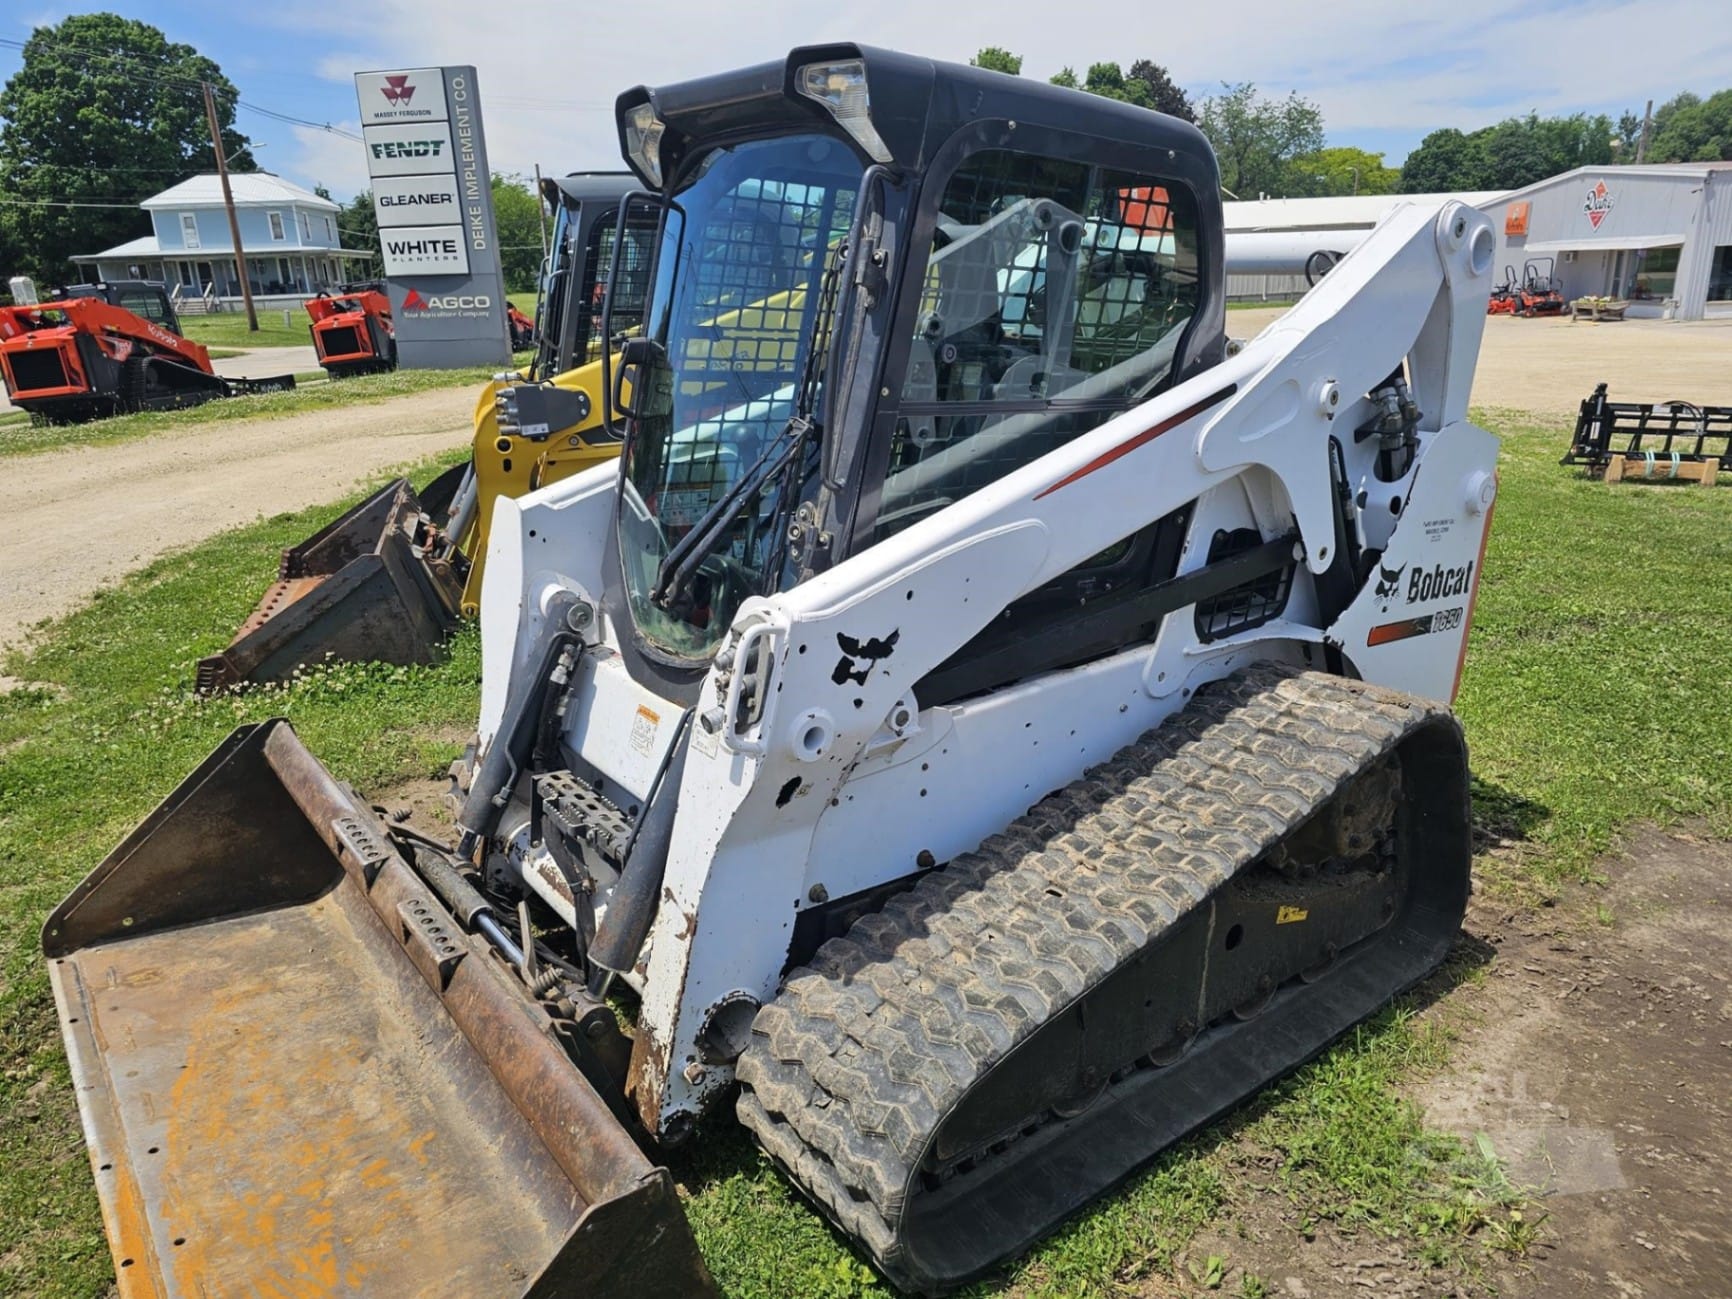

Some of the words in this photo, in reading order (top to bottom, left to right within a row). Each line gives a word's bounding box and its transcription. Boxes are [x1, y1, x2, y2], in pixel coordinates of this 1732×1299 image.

[452, 74, 467, 101] CO.
[374, 111, 397, 119] MASSEY
[399, 109, 432, 117] FERGUSON
[370, 140, 445, 159] FENDT
[456, 105, 480, 200] IMPLEMENT
[380, 193, 452, 207] GLEANER
[469, 206, 486, 250] DEIKE
[387, 240, 457, 255] WHITE
[428, 295, 490, 309] AGCO
[458, 311, 490, 319] Company
[1406, 560, 1473, 605] Bobcat
